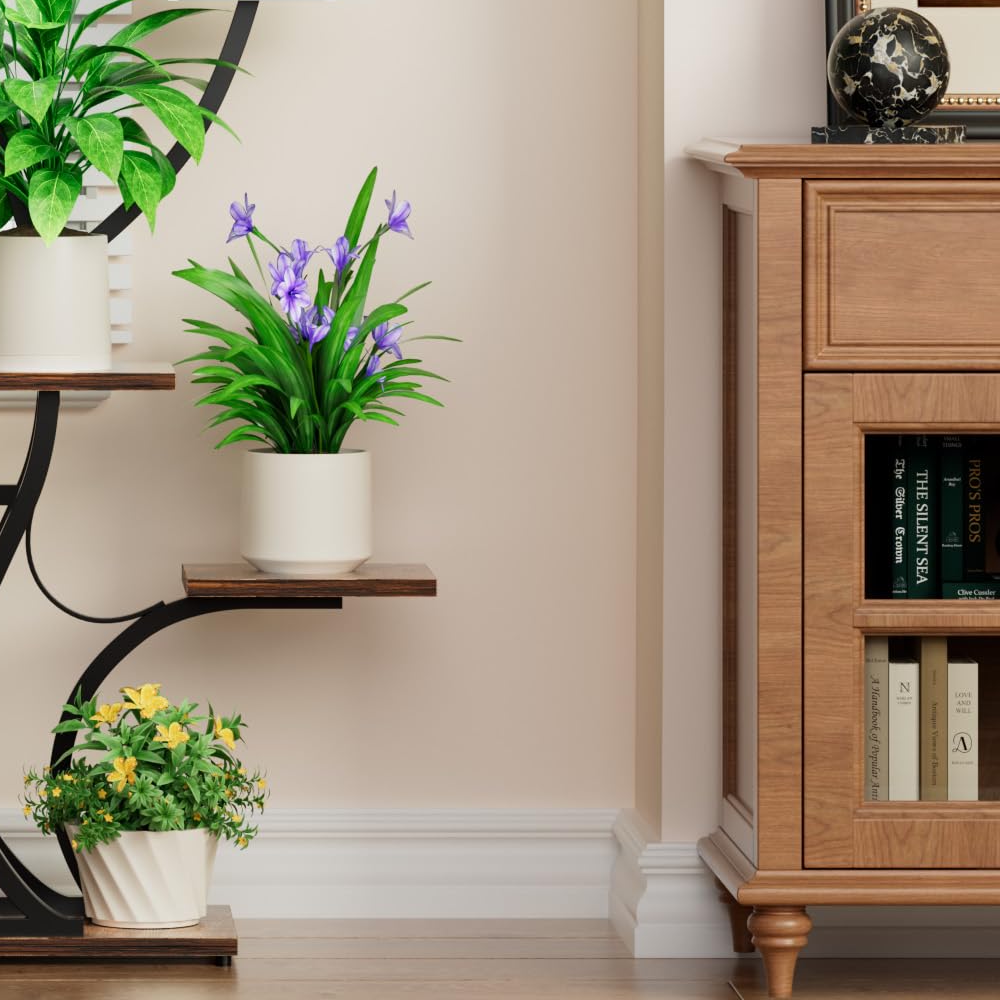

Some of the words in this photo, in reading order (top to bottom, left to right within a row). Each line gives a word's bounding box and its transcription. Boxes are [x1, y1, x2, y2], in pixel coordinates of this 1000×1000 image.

[916, 469, 928, 500] THE
[968, 459, 982, 501] PRO'S
[916, 503, 928, 555] SILENT
[968, 504, 981, 543] PROS
[916, 557, 928, 585] SEA
[900, 682, 910, 693] N
[870, 686, 881, 733] Handbook
[869, 733, 881, 745] of
[868, 745, 880, 778] Popular
